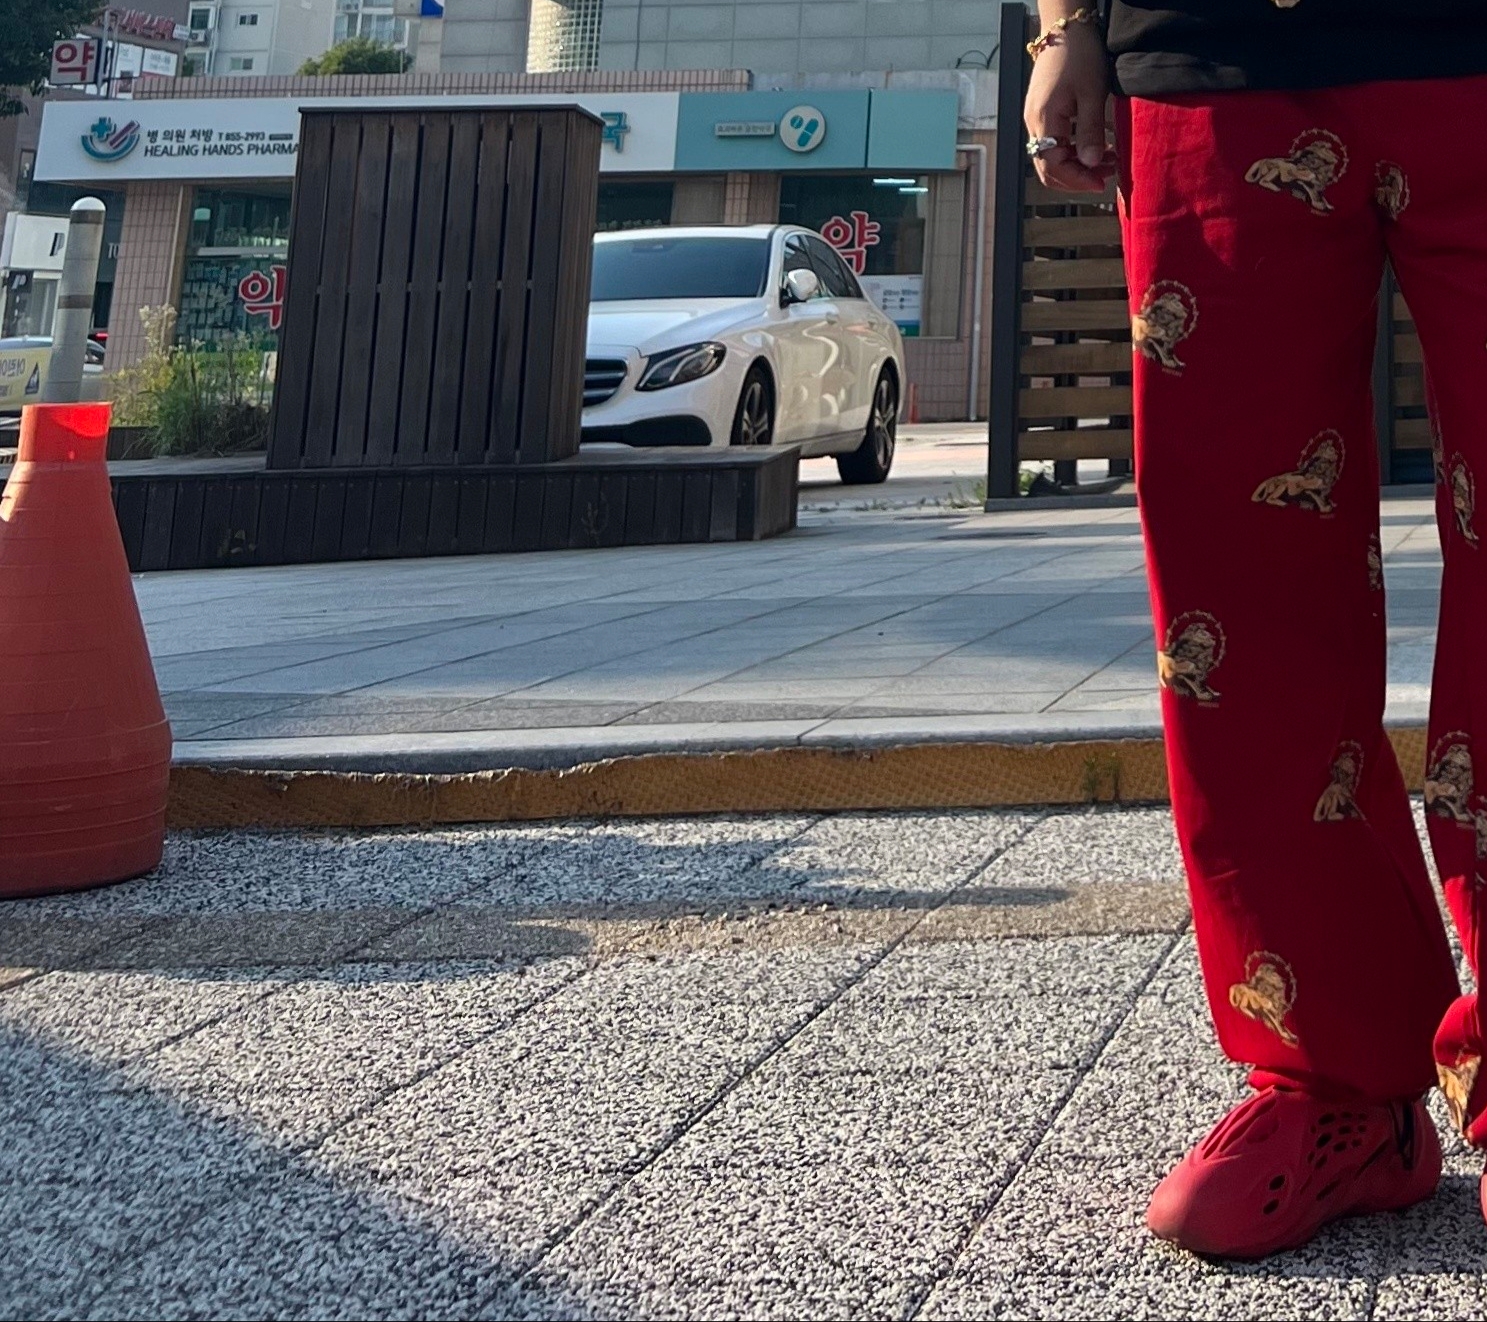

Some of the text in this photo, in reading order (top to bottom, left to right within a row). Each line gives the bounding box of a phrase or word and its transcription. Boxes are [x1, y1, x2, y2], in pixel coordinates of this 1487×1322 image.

[55, 41, 95, 82] 약
[144, 144, 199, 157] HEALING
[202, 143, 244, 156] HANDS
[821, 211, 881, 276] 약
